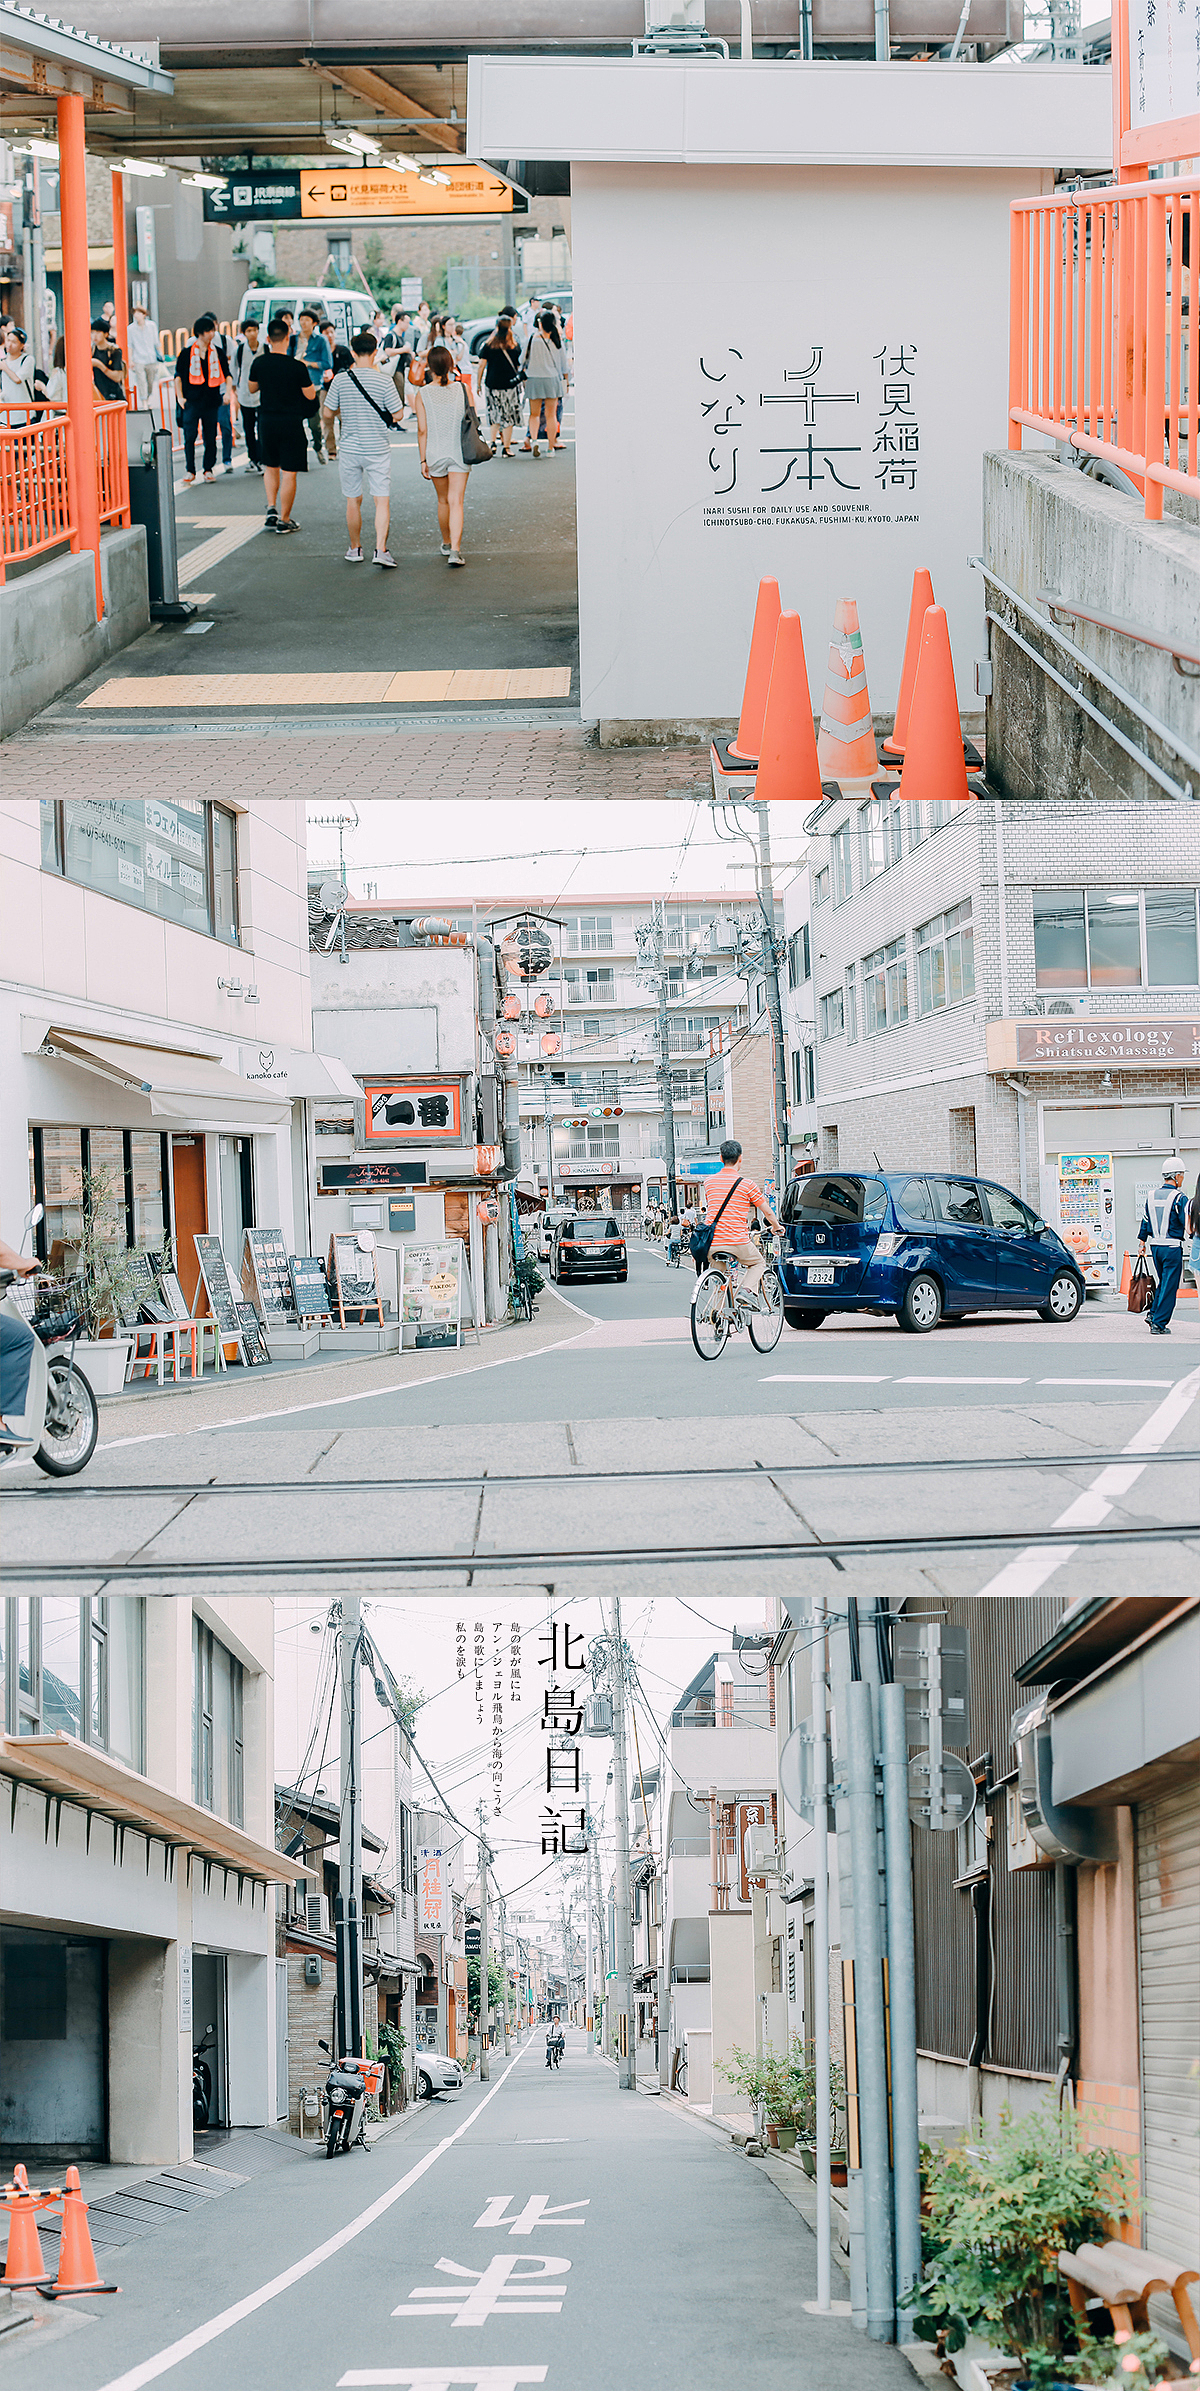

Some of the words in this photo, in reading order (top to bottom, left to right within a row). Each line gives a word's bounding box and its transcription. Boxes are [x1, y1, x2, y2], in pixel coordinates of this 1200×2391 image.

[699, 347, 746, 495] いなり
[872, 344, 919, 490] 伏見稲荷
[703, 506, 725, 515] INARI
[727, 506, 750, 515] SUSHI
[752, 506, 767, 514] FOR
[770, 505, 793, 514] DAILY
[795, 505, 810, 514] USE
[812, 505, 829, 513] AND
[831, 504, 873, 513] SOUVENIR.
[894, 514, 920, 524] JAPAN
[147, 853, 171, 879] ネイル
[1035, 1027, 1173, 1046] Reflexology
[1035, 1045, 1175, 1058] Shiatsu&Massage
[246, 1072, 272, 1080] kanoko
[273, 1070, 288, 1079] café
[421, 1858, 443, 1920] 月桂冠
